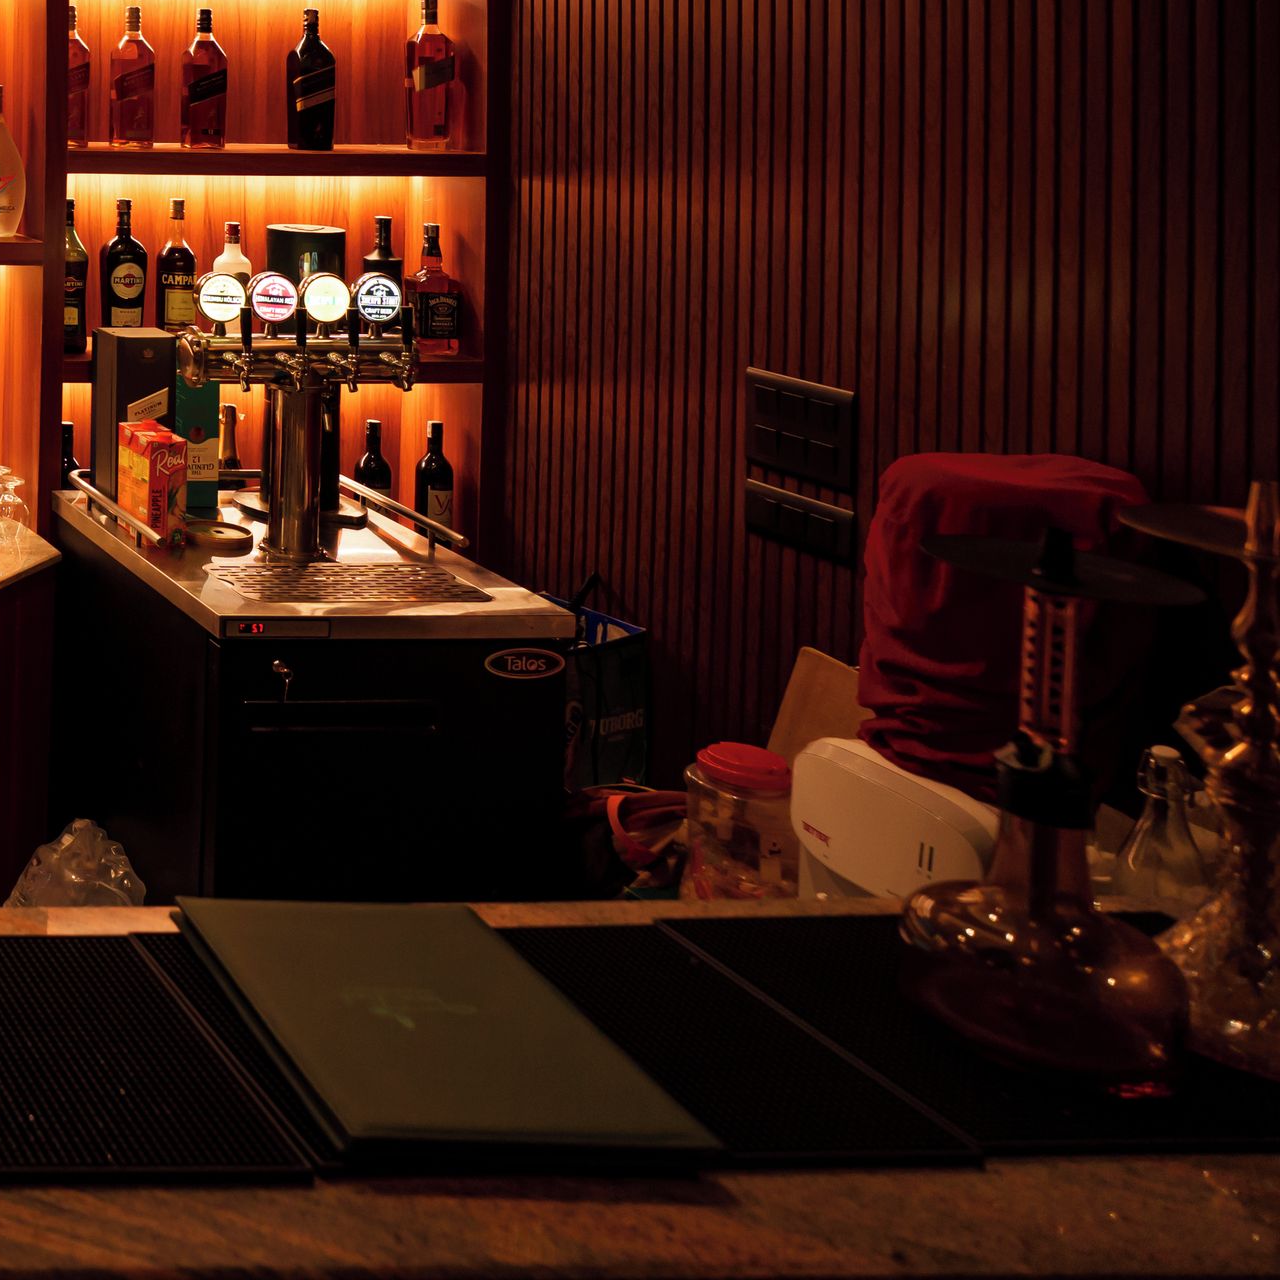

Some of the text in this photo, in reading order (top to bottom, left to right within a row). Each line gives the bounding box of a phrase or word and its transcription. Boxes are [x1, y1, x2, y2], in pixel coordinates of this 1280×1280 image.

[113, 277, 144, 287] MARTINI
[151, 448, 187, 480] Real
[151, 487, 163, 531] PINEAPPLE
[502, 653, 548, 674] Talos
